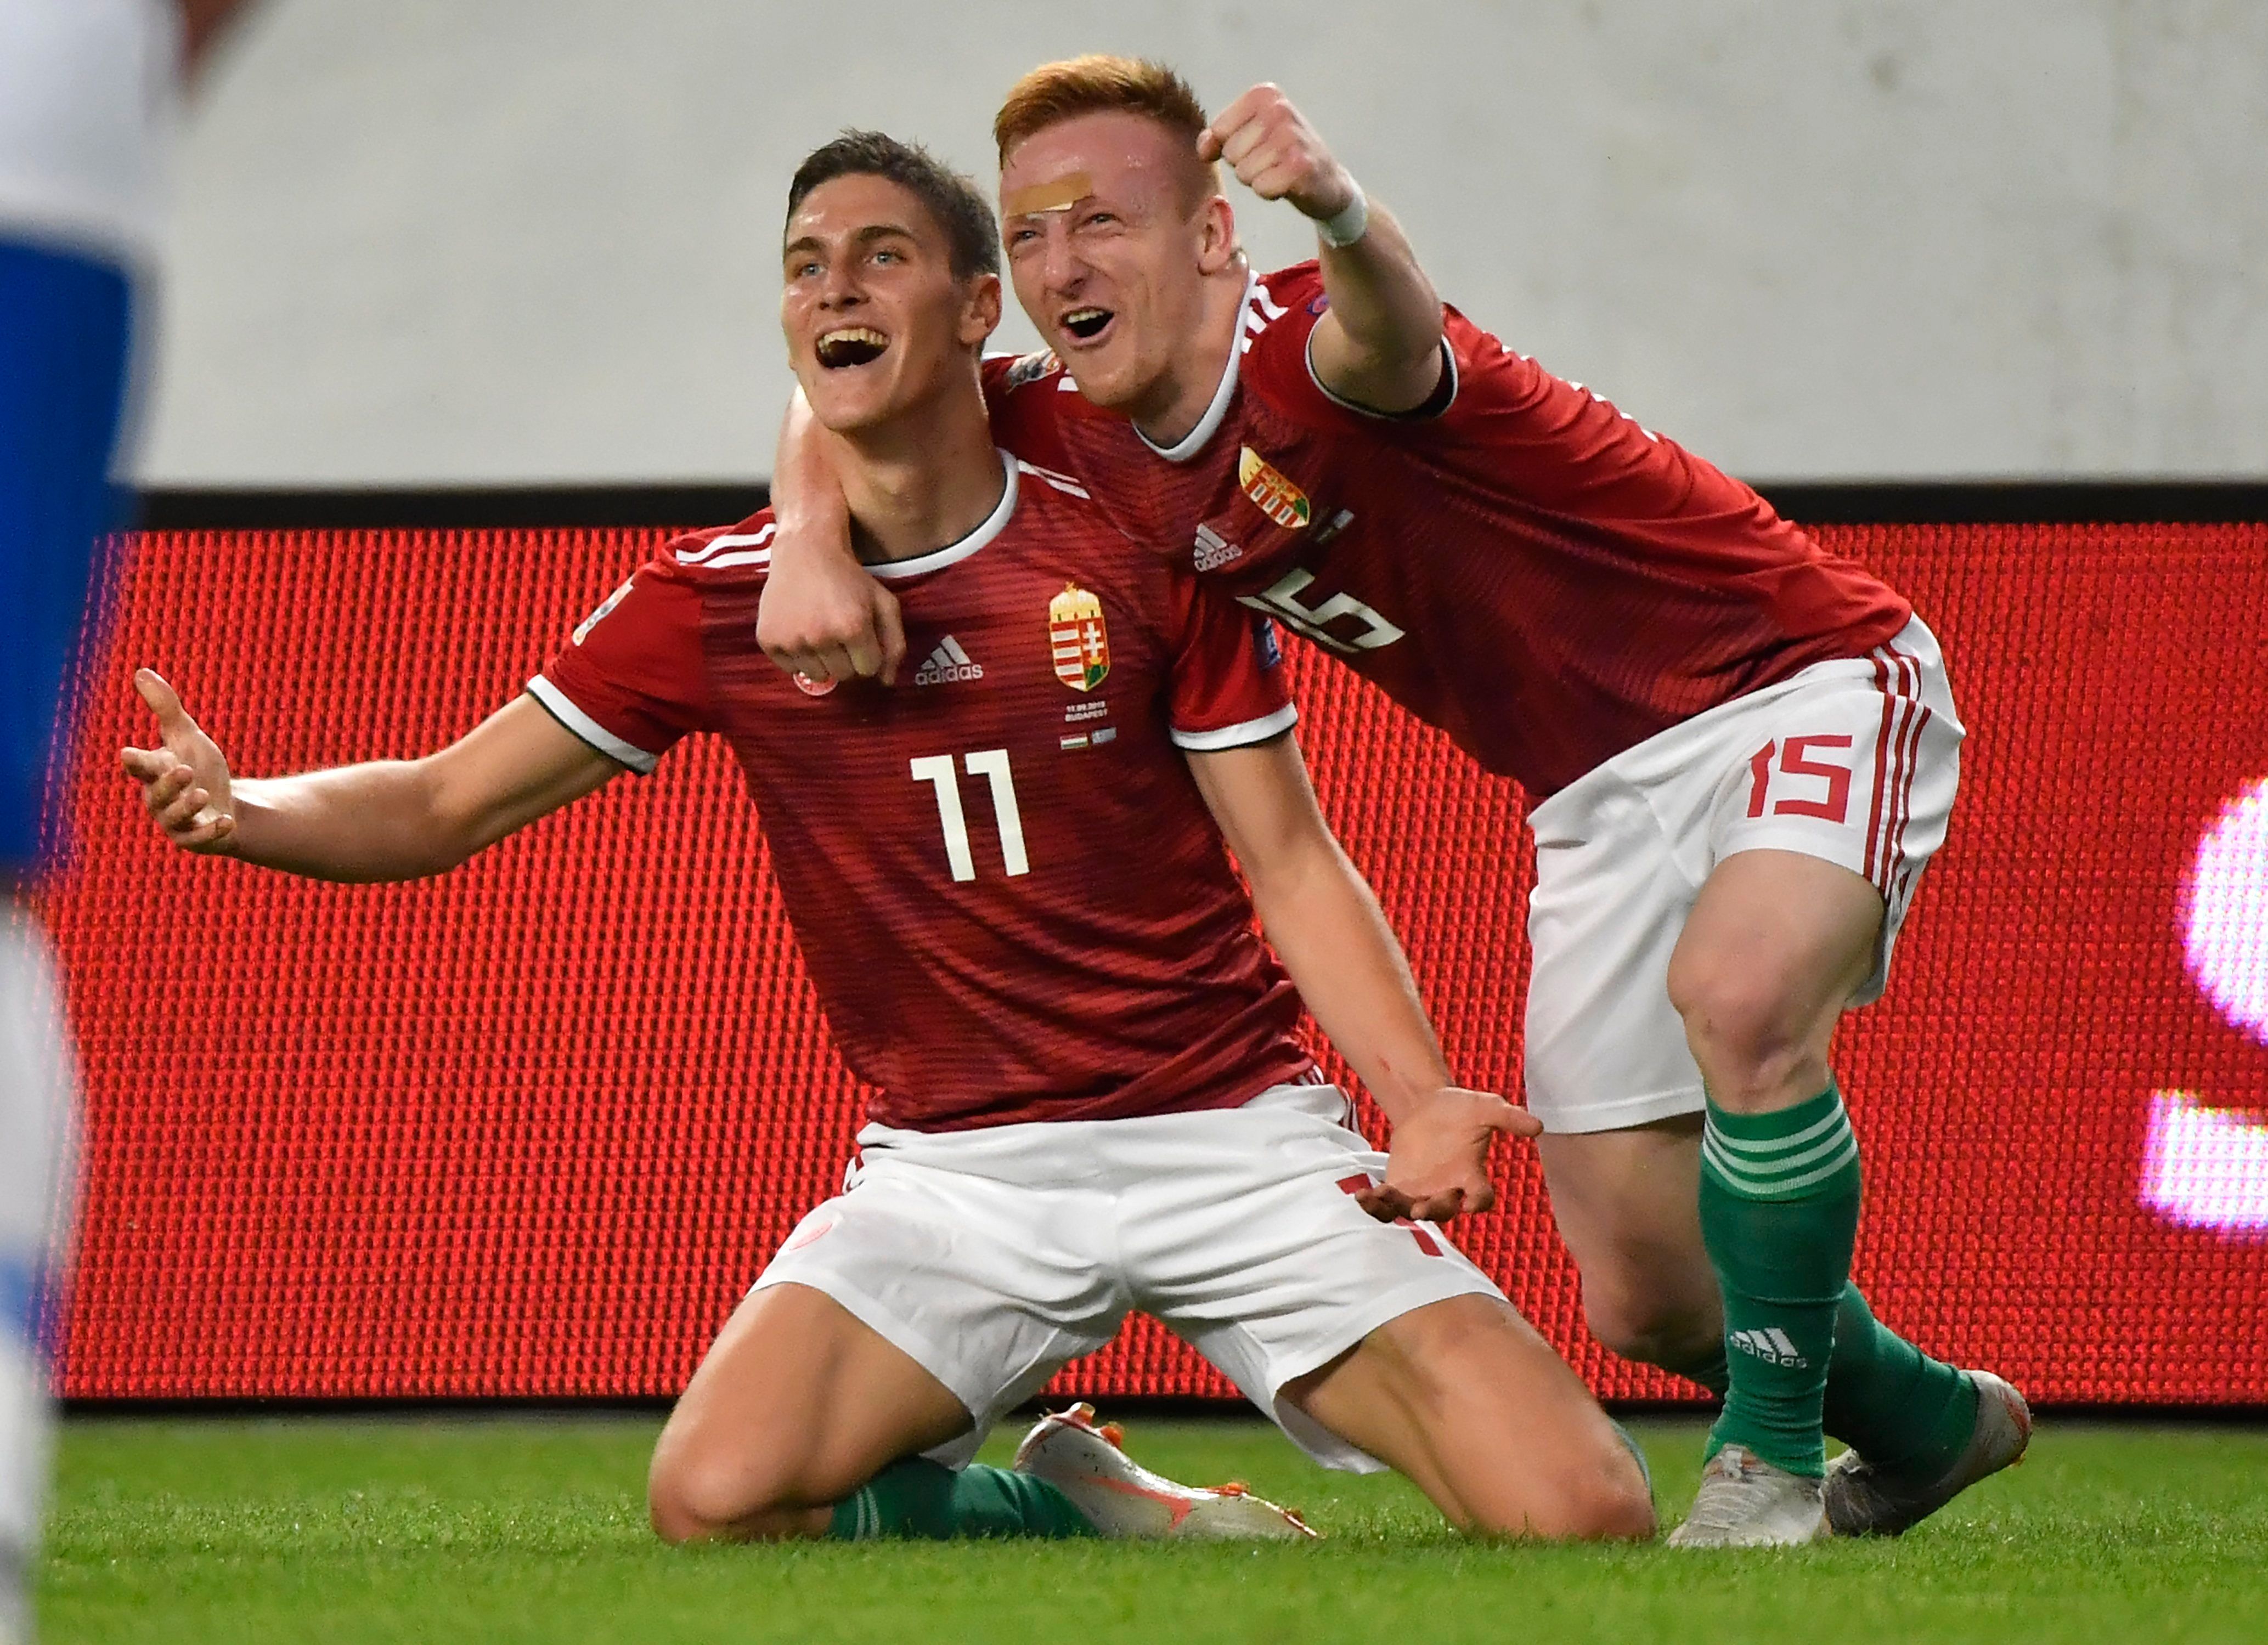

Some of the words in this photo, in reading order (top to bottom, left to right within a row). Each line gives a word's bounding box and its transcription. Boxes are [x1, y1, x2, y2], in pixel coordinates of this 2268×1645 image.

[1194, 544, 1243, 572] adidas
[915, 664, 984, 686] adidas
[1065, 708, 1108, 722] BUDAPEST
[1747, 734, 1853, 824] 15
[910, 749, 1030, 881] 11
[1730, 1335, 1808, 1369] adidas
